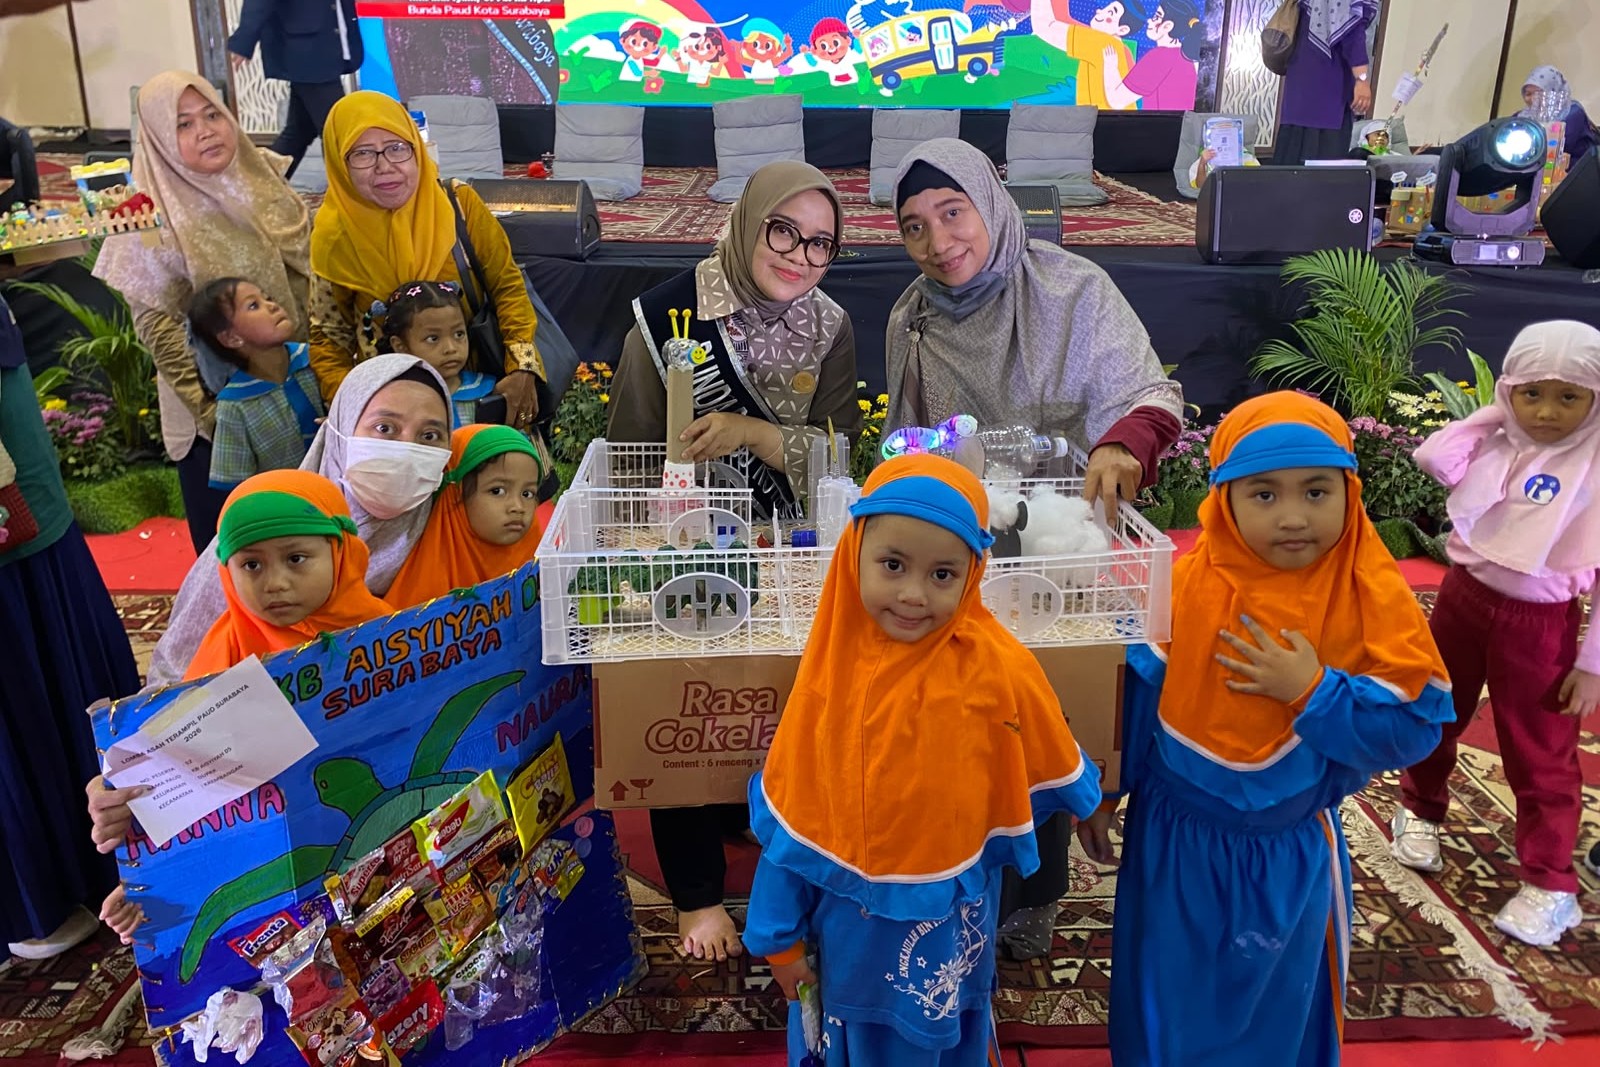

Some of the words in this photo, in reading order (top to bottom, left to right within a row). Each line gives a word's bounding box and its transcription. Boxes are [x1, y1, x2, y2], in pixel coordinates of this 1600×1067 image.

[408, 5, 442, 15] Bunda
[444, 5, 471, 15] Paud
[474, 5, 499, 15] Kota
[502, 5, 551, 17] Surabaya
[515, 18, 556, 67] urabaya
[343, 589, 513, 683] AISYIYAH
[322, 627, 502, 721] SURABAYA
[496, 666, 588, 753] NAURA
[680, 681, 778, 717] Rasa
[120, 749, 146, 765] LOMBA
[147, 741, 166, 755] ASAH
[165, 719, 198, 744] TERAMPIL
[197, 706, 215, 722] PAUD
[215, 684, 249, 709] SURABAYA
[184, 728, 202, 743] 2026
[645, 715, 779, 754] Cokela
[165, 774, 182, 784] PAUD
[663, 759, 699, 769] Content
[707, 759, 713, 767] 6
[716, 758, 752, 769] renceng
[152, 781, 187, 801] KELURAHAN
[158, 788, 194, 810] KECAMATAN
[245, 918, 286, 955] Frenta
[455, 952, 486, 979] CHOCO
